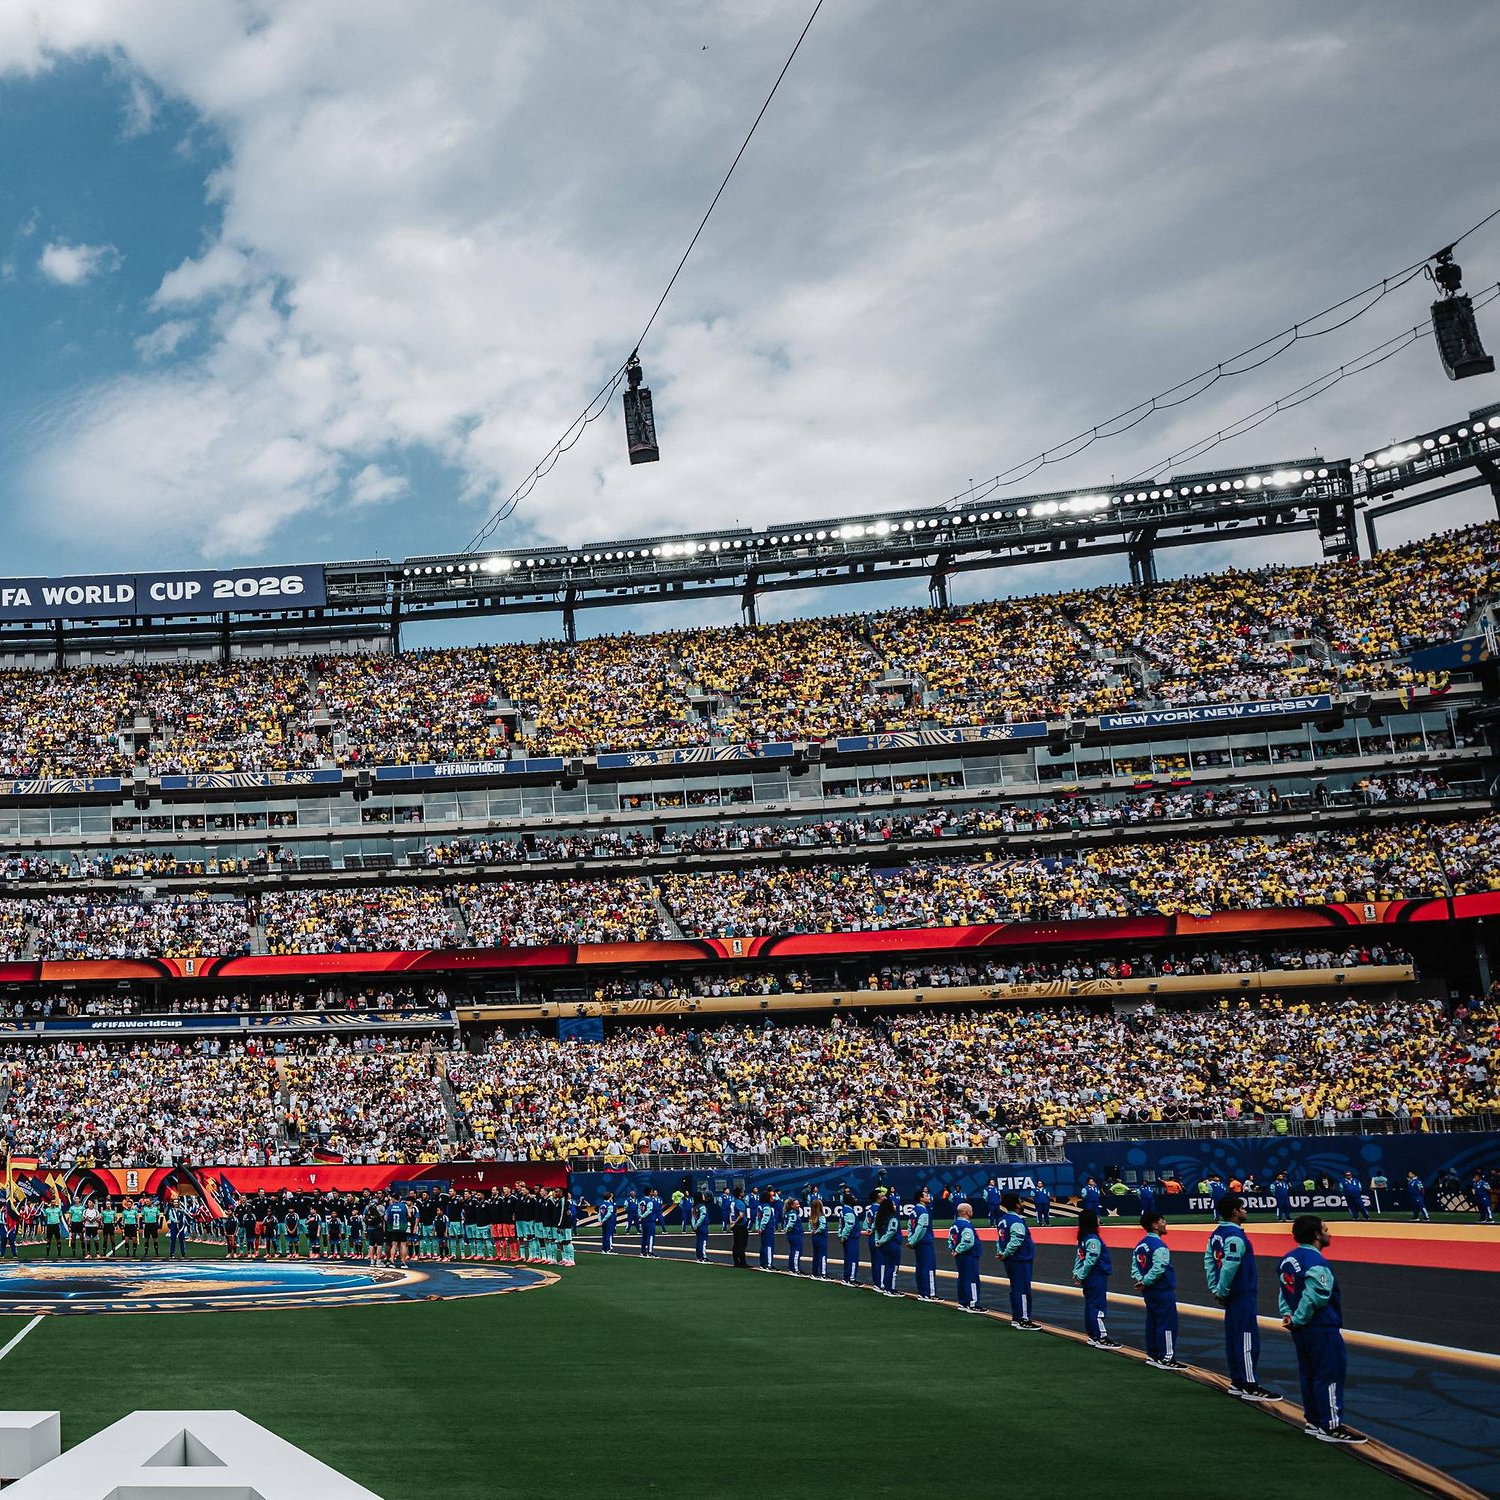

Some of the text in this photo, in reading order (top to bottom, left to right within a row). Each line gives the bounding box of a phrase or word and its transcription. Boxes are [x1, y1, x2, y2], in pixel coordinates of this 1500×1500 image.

[42, 584, 135, 606] WORLD
[150, 581, 202, 600] CUP
[213, 575, 303, 598] 2026
[1109, 699, 1319, 726] NEW YORK NEW JERSEY
[434, 763, 505, 777] #FIFAWorldCup
[92, 1020, 183, 1029] #FIFAWorldCup
[997, 1176, 1036, 1190] FIFA
[1289, 1196, 1310, 1208] UP
[70, 1303, 194, 1311] CUP
